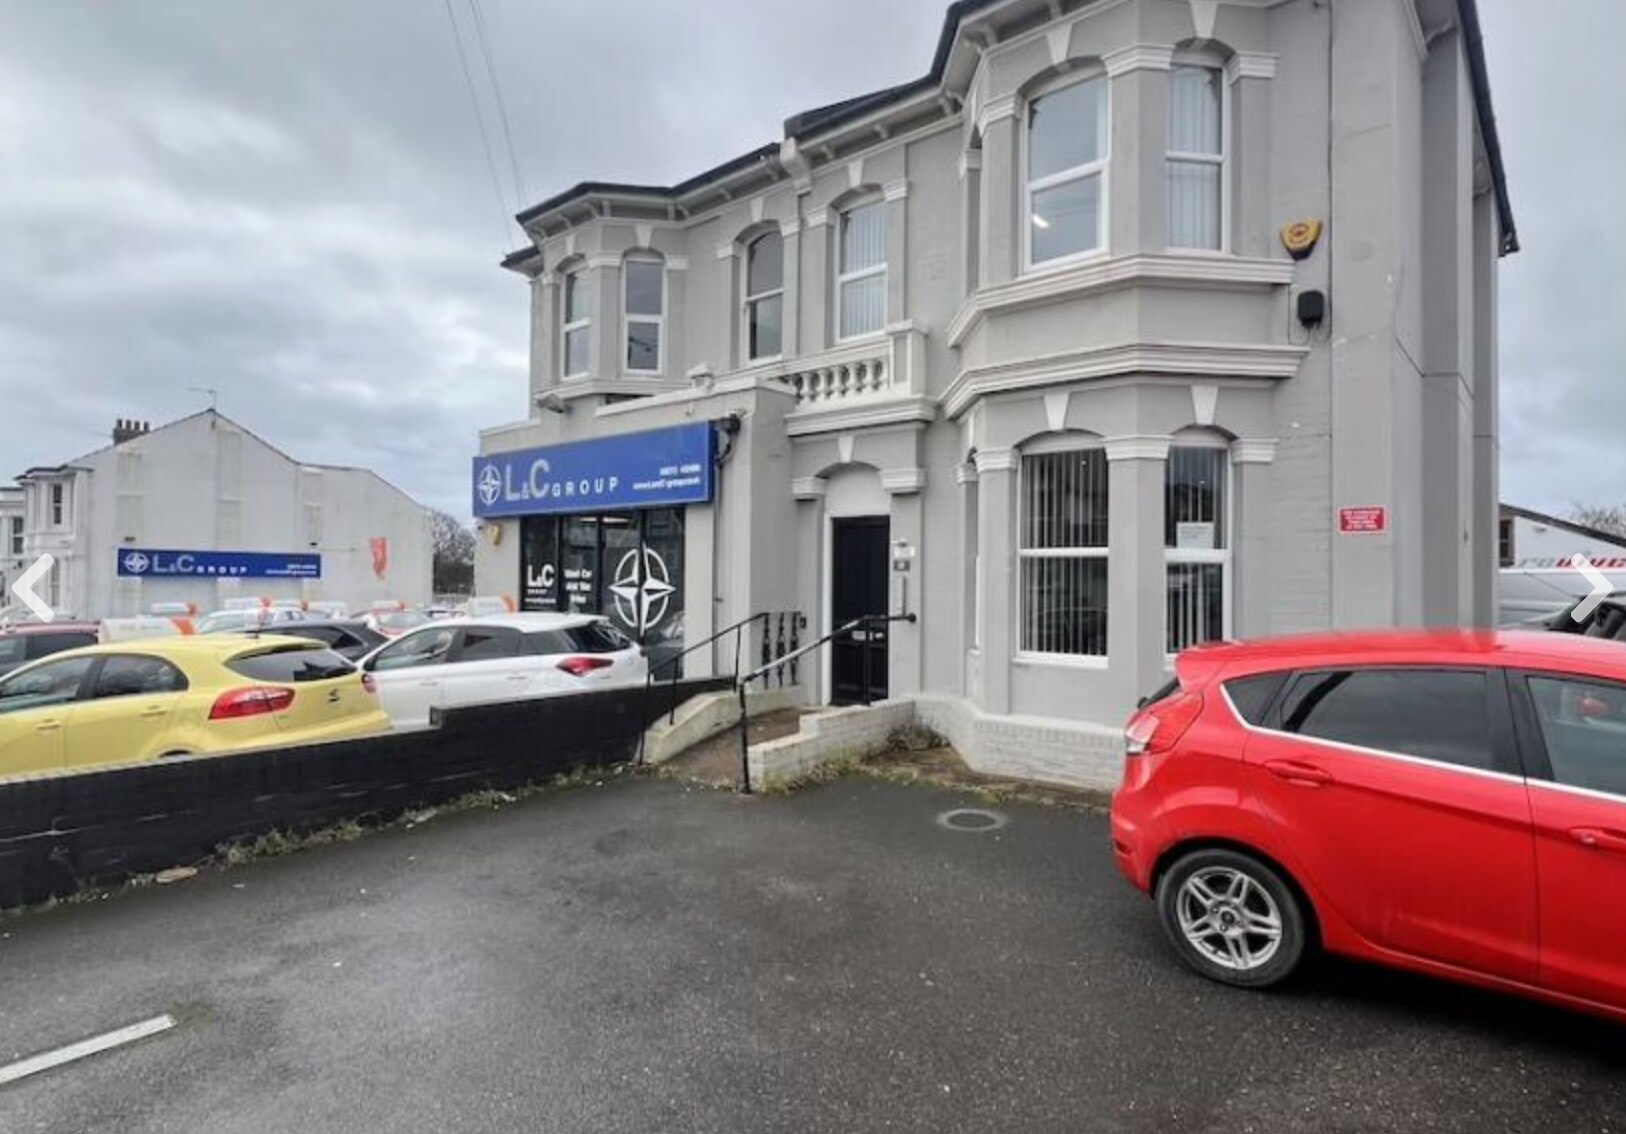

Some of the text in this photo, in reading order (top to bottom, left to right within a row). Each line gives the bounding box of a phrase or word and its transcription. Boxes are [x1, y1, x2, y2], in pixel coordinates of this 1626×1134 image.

[505, 459, 550, 501] L&C
[552, 476, 619, 498] GROUP
[196, 565, 248, 575] GROUP
